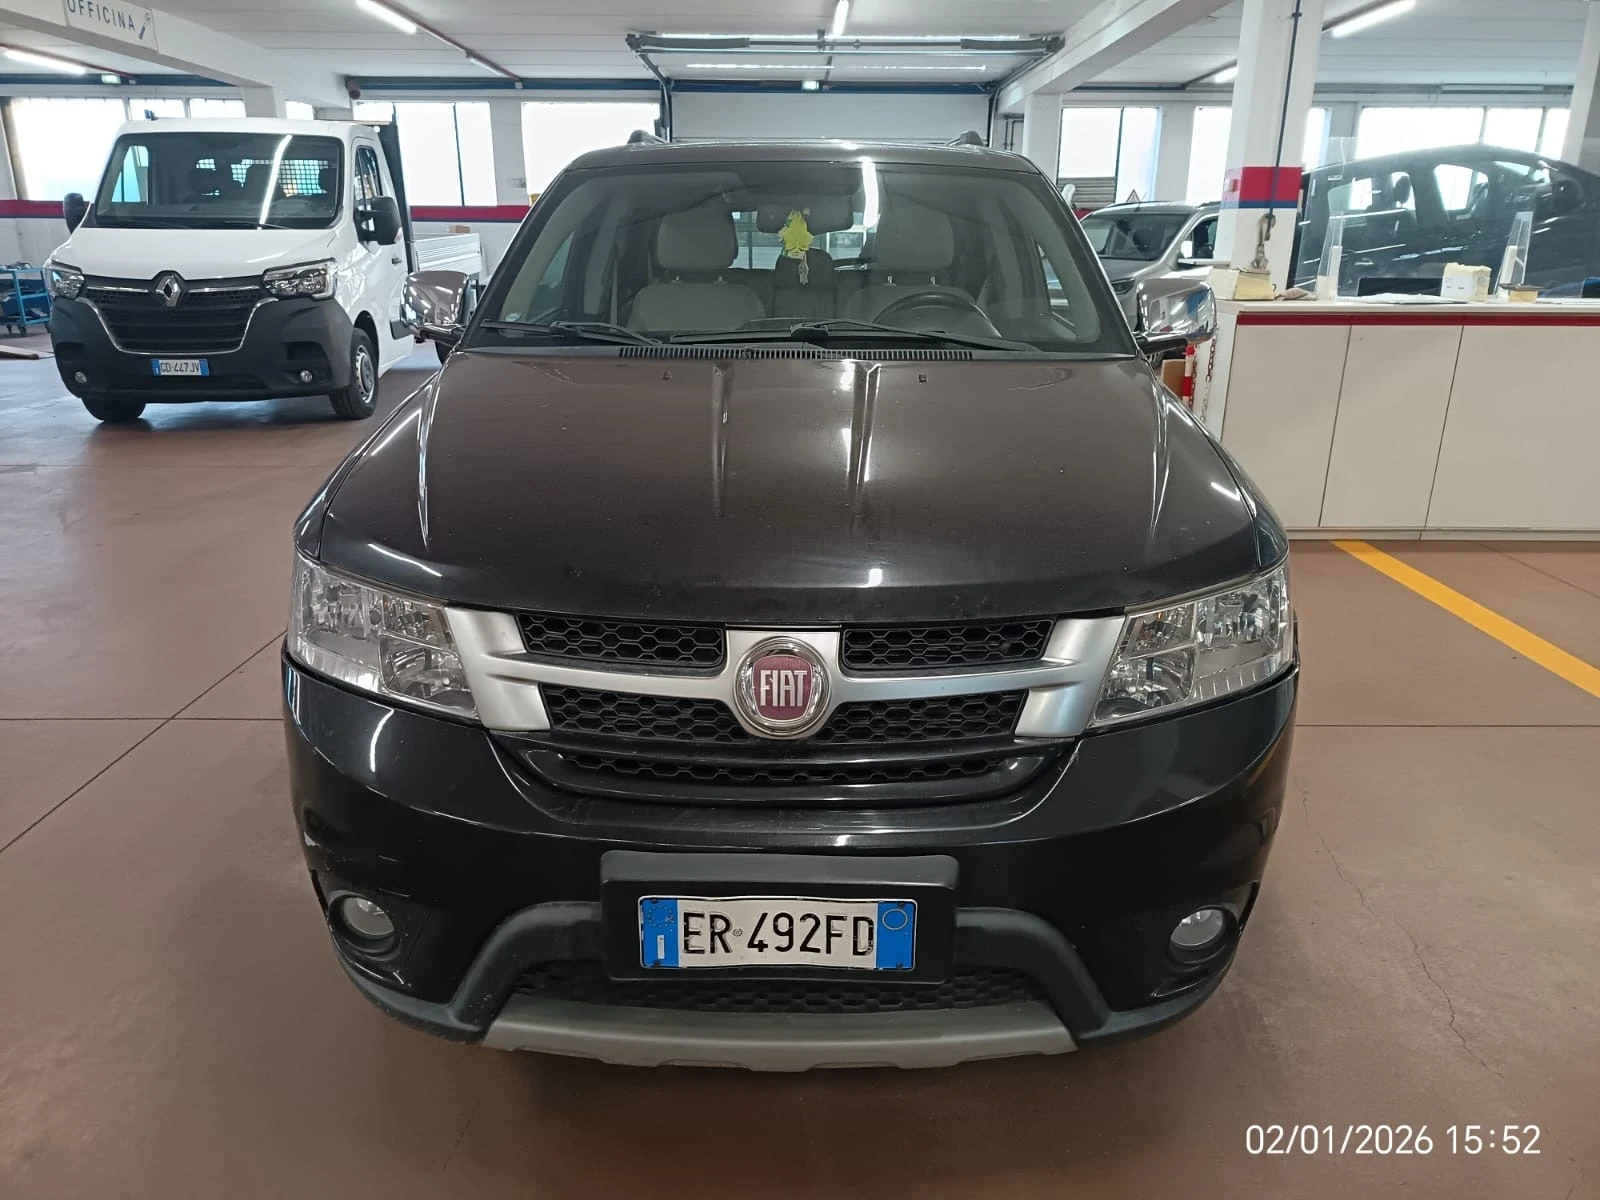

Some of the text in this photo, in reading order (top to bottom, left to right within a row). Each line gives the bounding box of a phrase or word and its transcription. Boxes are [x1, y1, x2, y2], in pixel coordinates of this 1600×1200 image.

[67, 0, 136, 31] OFFICINA
[760, 669, 808, 707] FIAT
[683, 911, 876, 957] ER 492FD
